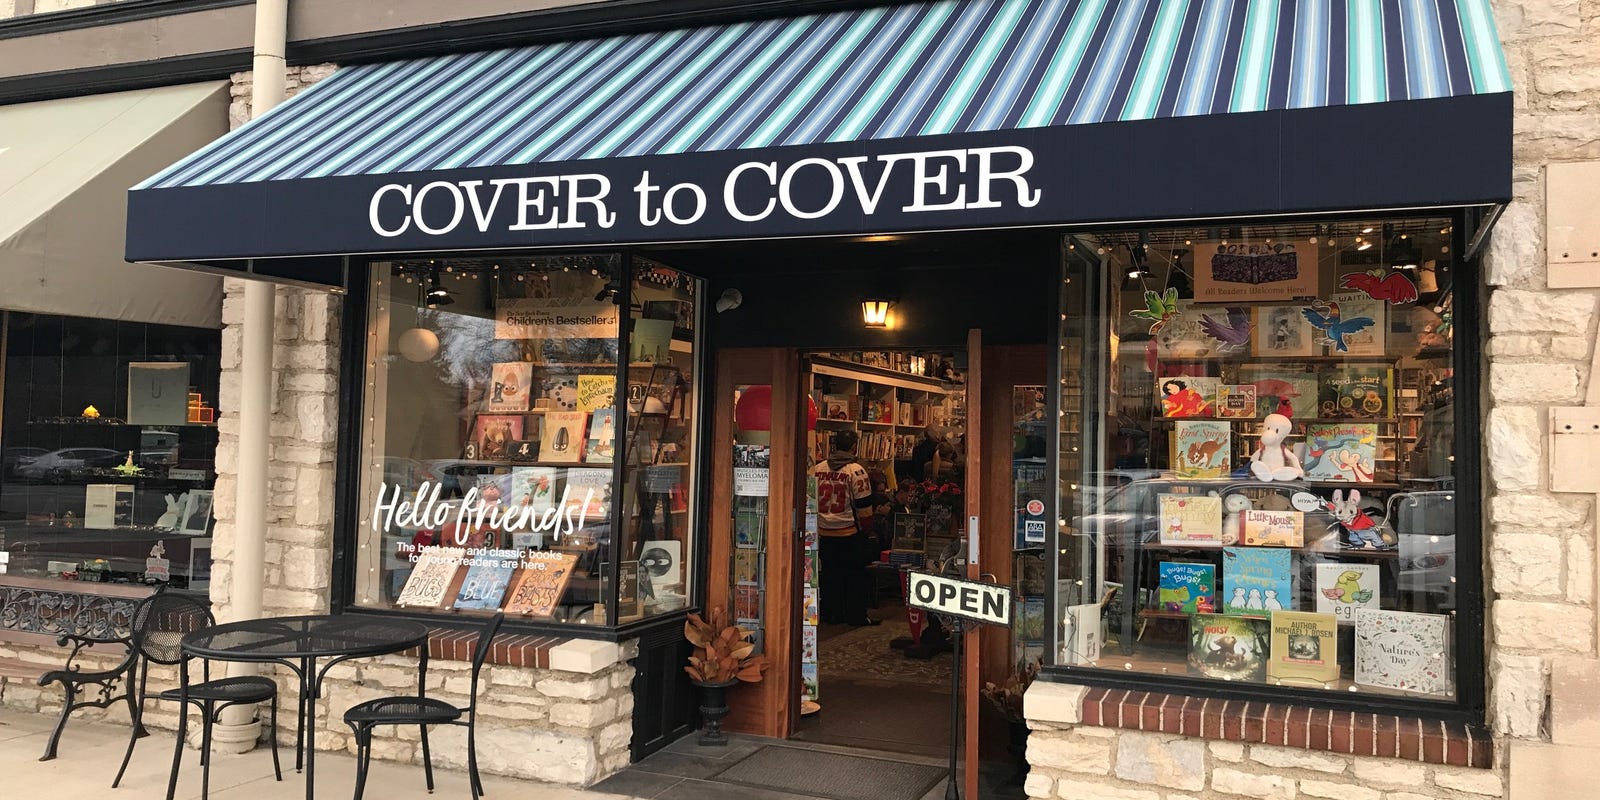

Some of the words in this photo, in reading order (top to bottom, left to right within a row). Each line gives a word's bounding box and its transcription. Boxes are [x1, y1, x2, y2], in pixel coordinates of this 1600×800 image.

[369, 173, 616, 237] COVER
[634, 171, 706, 226] to
[723, 145, 1041, 222] COVER
[506, 316, 555, 327] Children's
[556, 315, 614, 326] Bestsellers
[1332, 376, 1350, 385] seed
[1360, 375, 1380, 385] start
[466, 444, 475, 459] 3
[518, 443, 530, 456] 4
[372, 481, 456, 532] Hello
[455, 484, 595, 546] friends!
[485, 531, 495, 547] 9
[396, 542, 416, 552] The
[417, 543, 442, 554] best
[466, 546, 487, 558] and
[489, 547, 526, 559] classic
[528, 549, 563, 561] books
[458, 555, 499, 568] readers
[501, 560, 519, 569] are
[520, 559, 549, 571] here.
[1167, 566, 1186, 575] Bugs!
[1186, 567, 1207, 577] Bugs!
[1173, 574, 1201, 586] Bugs!
[407, 577, 442, 598] BUGS
[464, 579, 502, 600] BLUE
[915, 579, 1004, 618] OPEN
[1204, 625, 1229, 635] NOISY
[1275, 626, 1304, 637] MICHAEL
[1311, 629, 1334, 638] ROSEN
[1290, 621, 1317, 630] AUTHOR
[1380, 643, 1421, 656] Nature's
[1391, 656, 1408, 667] Day
